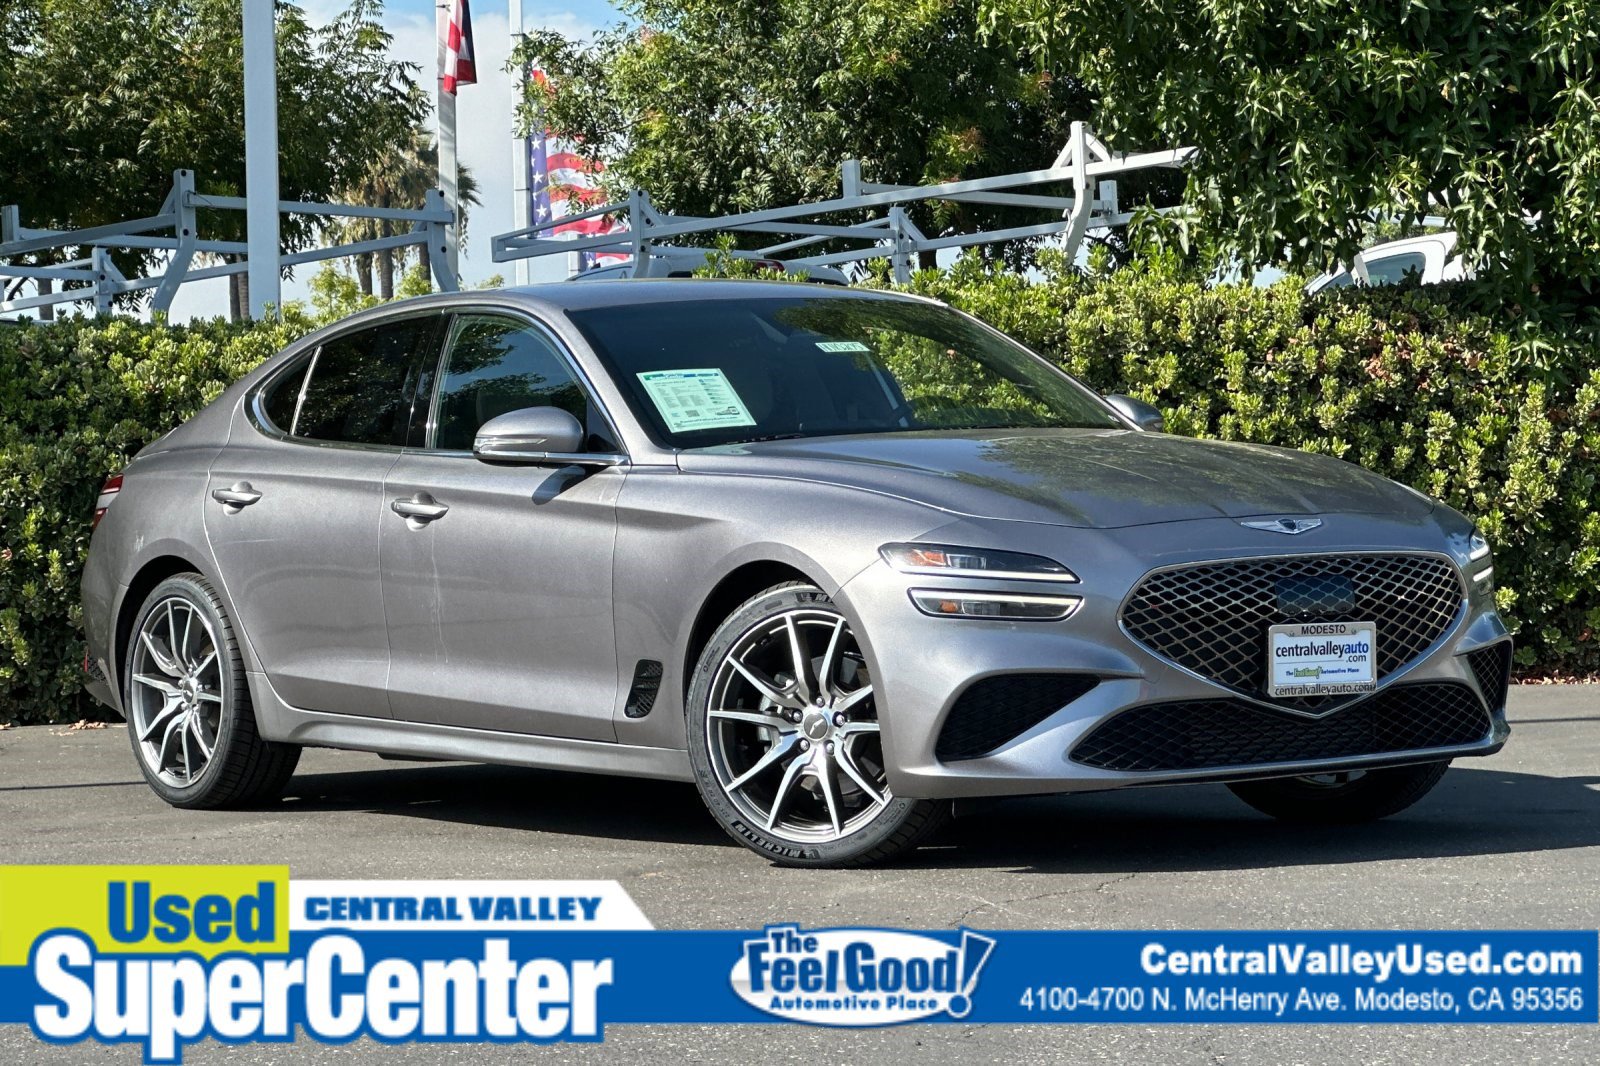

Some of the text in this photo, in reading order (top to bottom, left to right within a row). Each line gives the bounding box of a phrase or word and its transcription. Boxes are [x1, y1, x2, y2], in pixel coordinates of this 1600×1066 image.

[1301, 624, 1346, 635] MODESTO
[1275, 640, 1369, 658] centralvalleyauto
[1346, 655, 1367, 663] .com
[735, 822, 801, 859] MICHELIN
